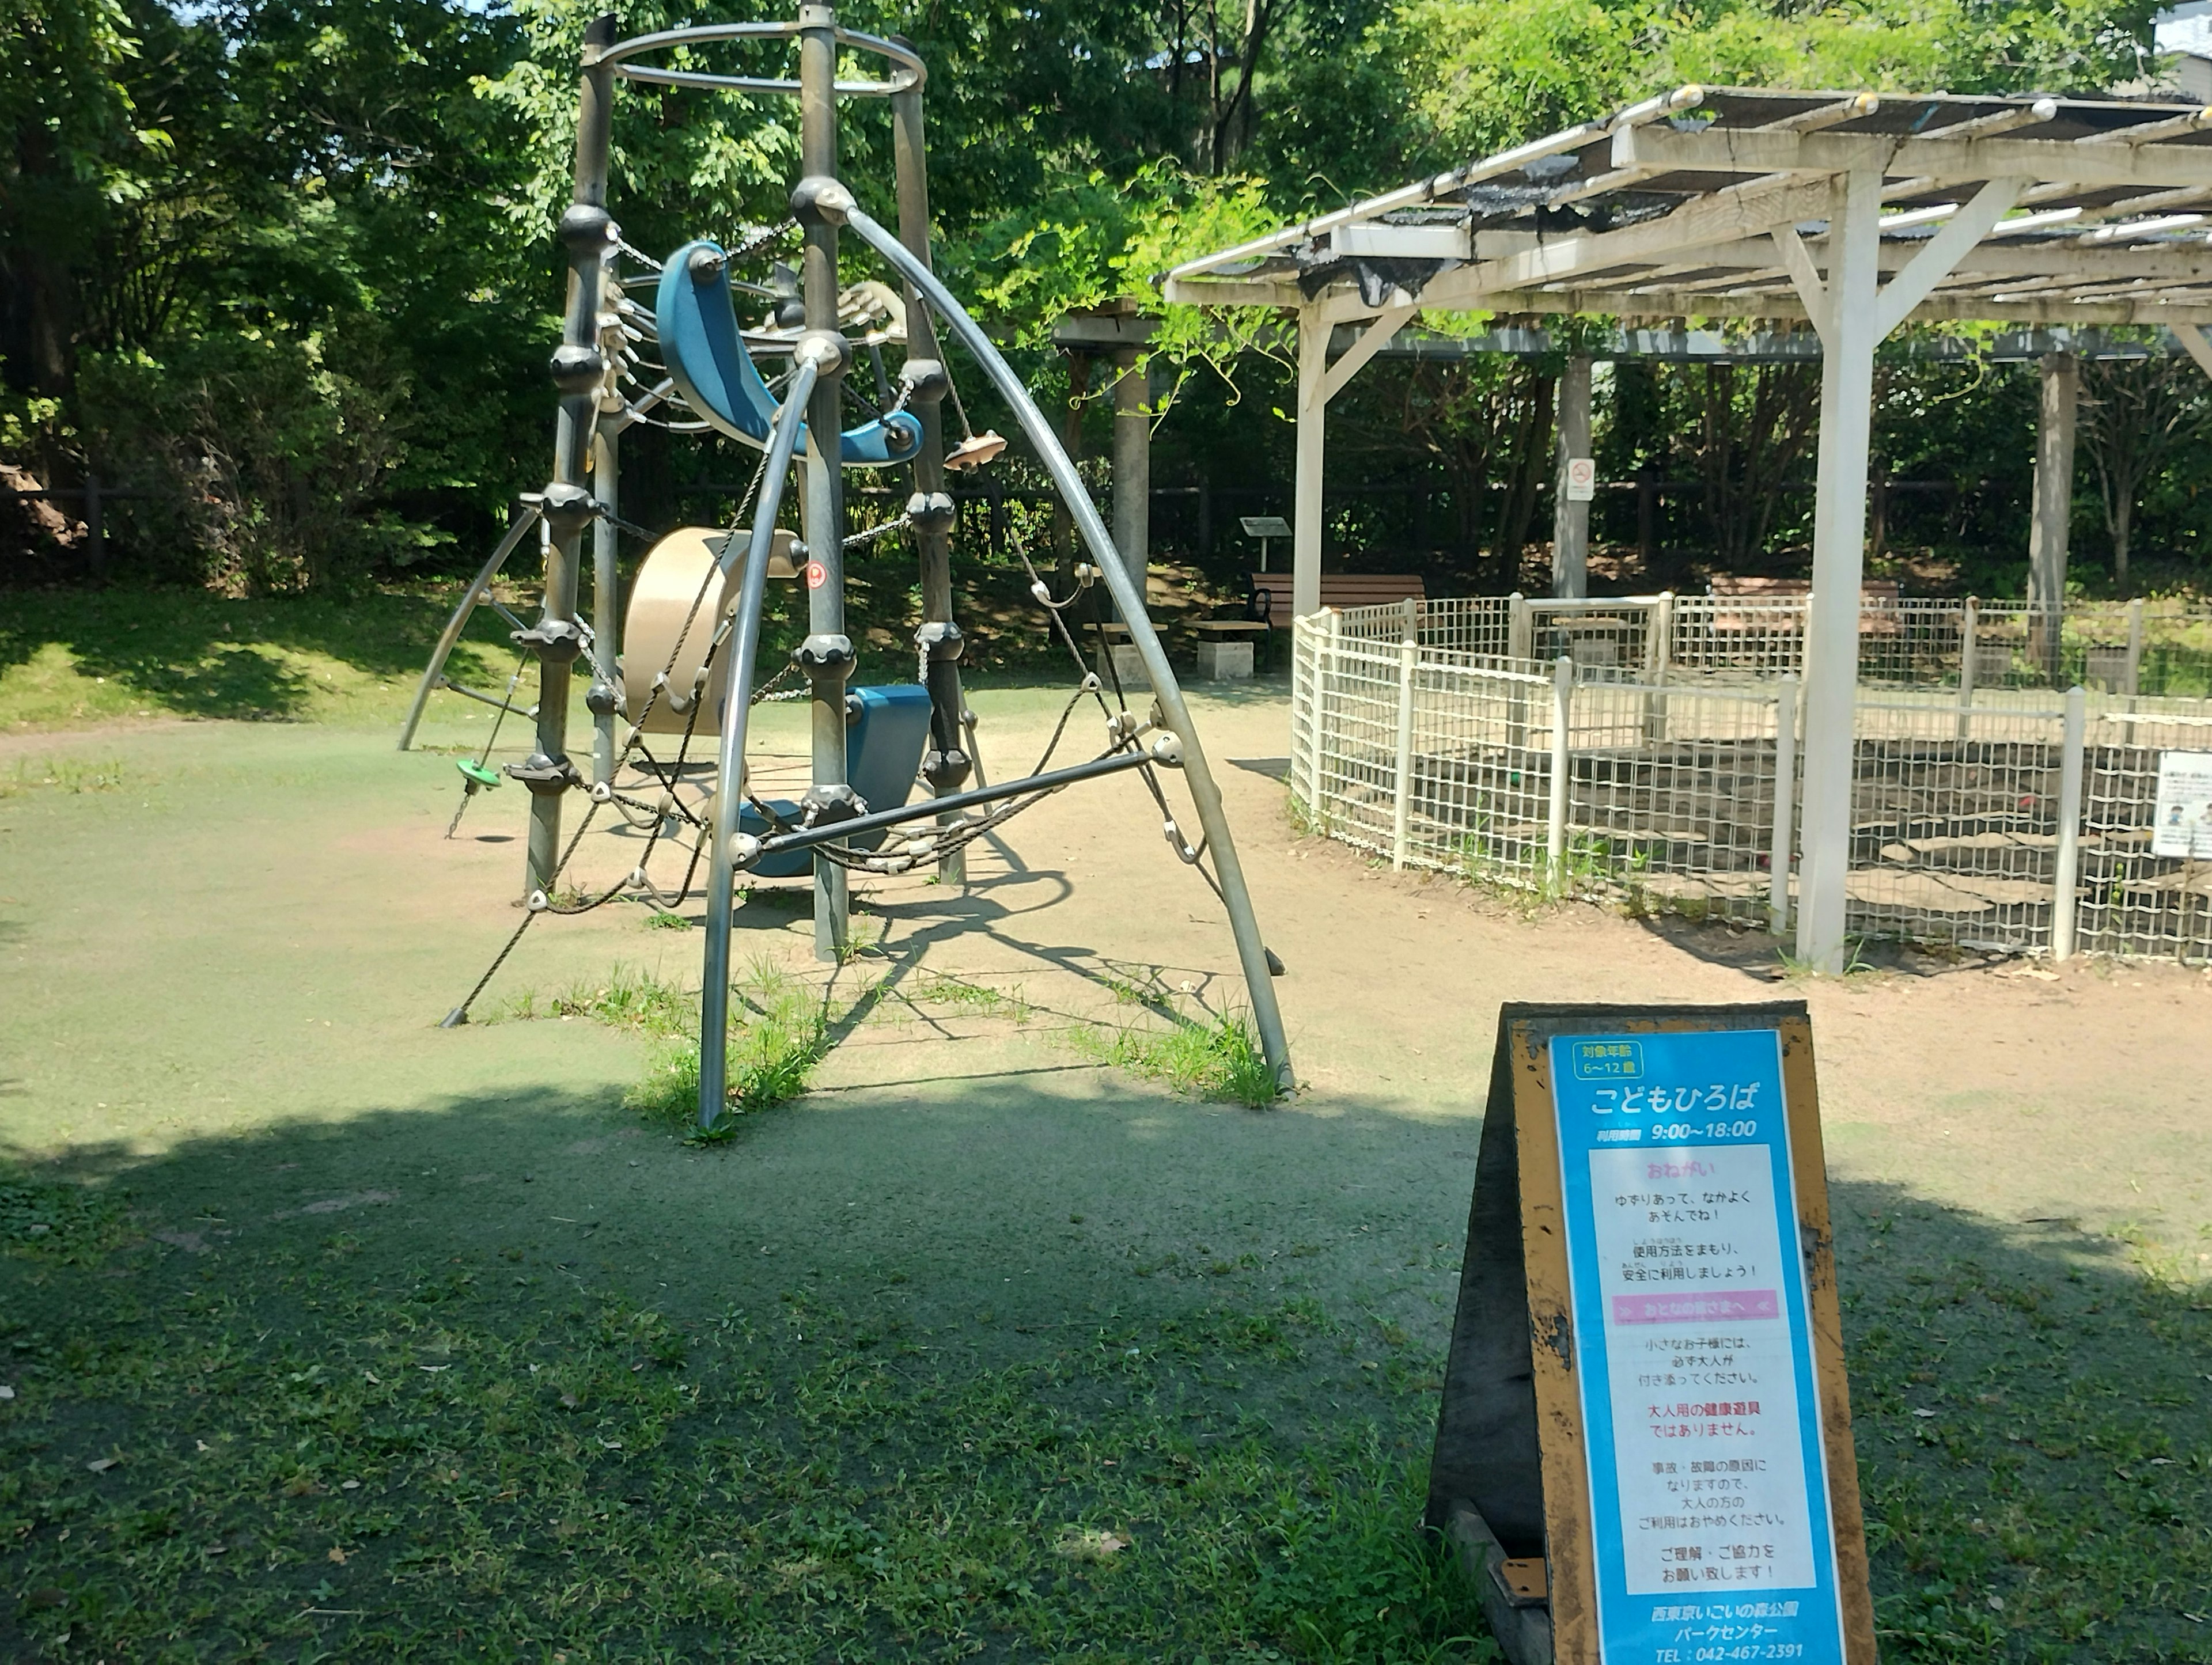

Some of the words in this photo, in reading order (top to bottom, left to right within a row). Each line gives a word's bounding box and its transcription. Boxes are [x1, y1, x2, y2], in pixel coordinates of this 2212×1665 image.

[1591, 1082, 1760, 1114] こどもひろば
[1647, 1160, 1715, 1179] おねがい
[1649, 1209, 1718, 1223] あそんでね！
[1633, 1243, 1738, 1258] 使用方法をまもり、
[1622, 1265, 1756, 1281] 安全に利用しましょう！
[1672, 1355, 1733, 1368] 必ず大人が
[1638, 1372, 1758, 1387] 付き添ってください。
[1649, 1422, 1755, 1438] ではありません。
[1667, 1478, 1748, 1492] なりますので、
[1681, 1496, 1745, 1510] 大人の方の
[1639, 1513, 1784, 1530] ご利用はおやめください。
[1674, 1623, 1778, 1642] パークセンター
